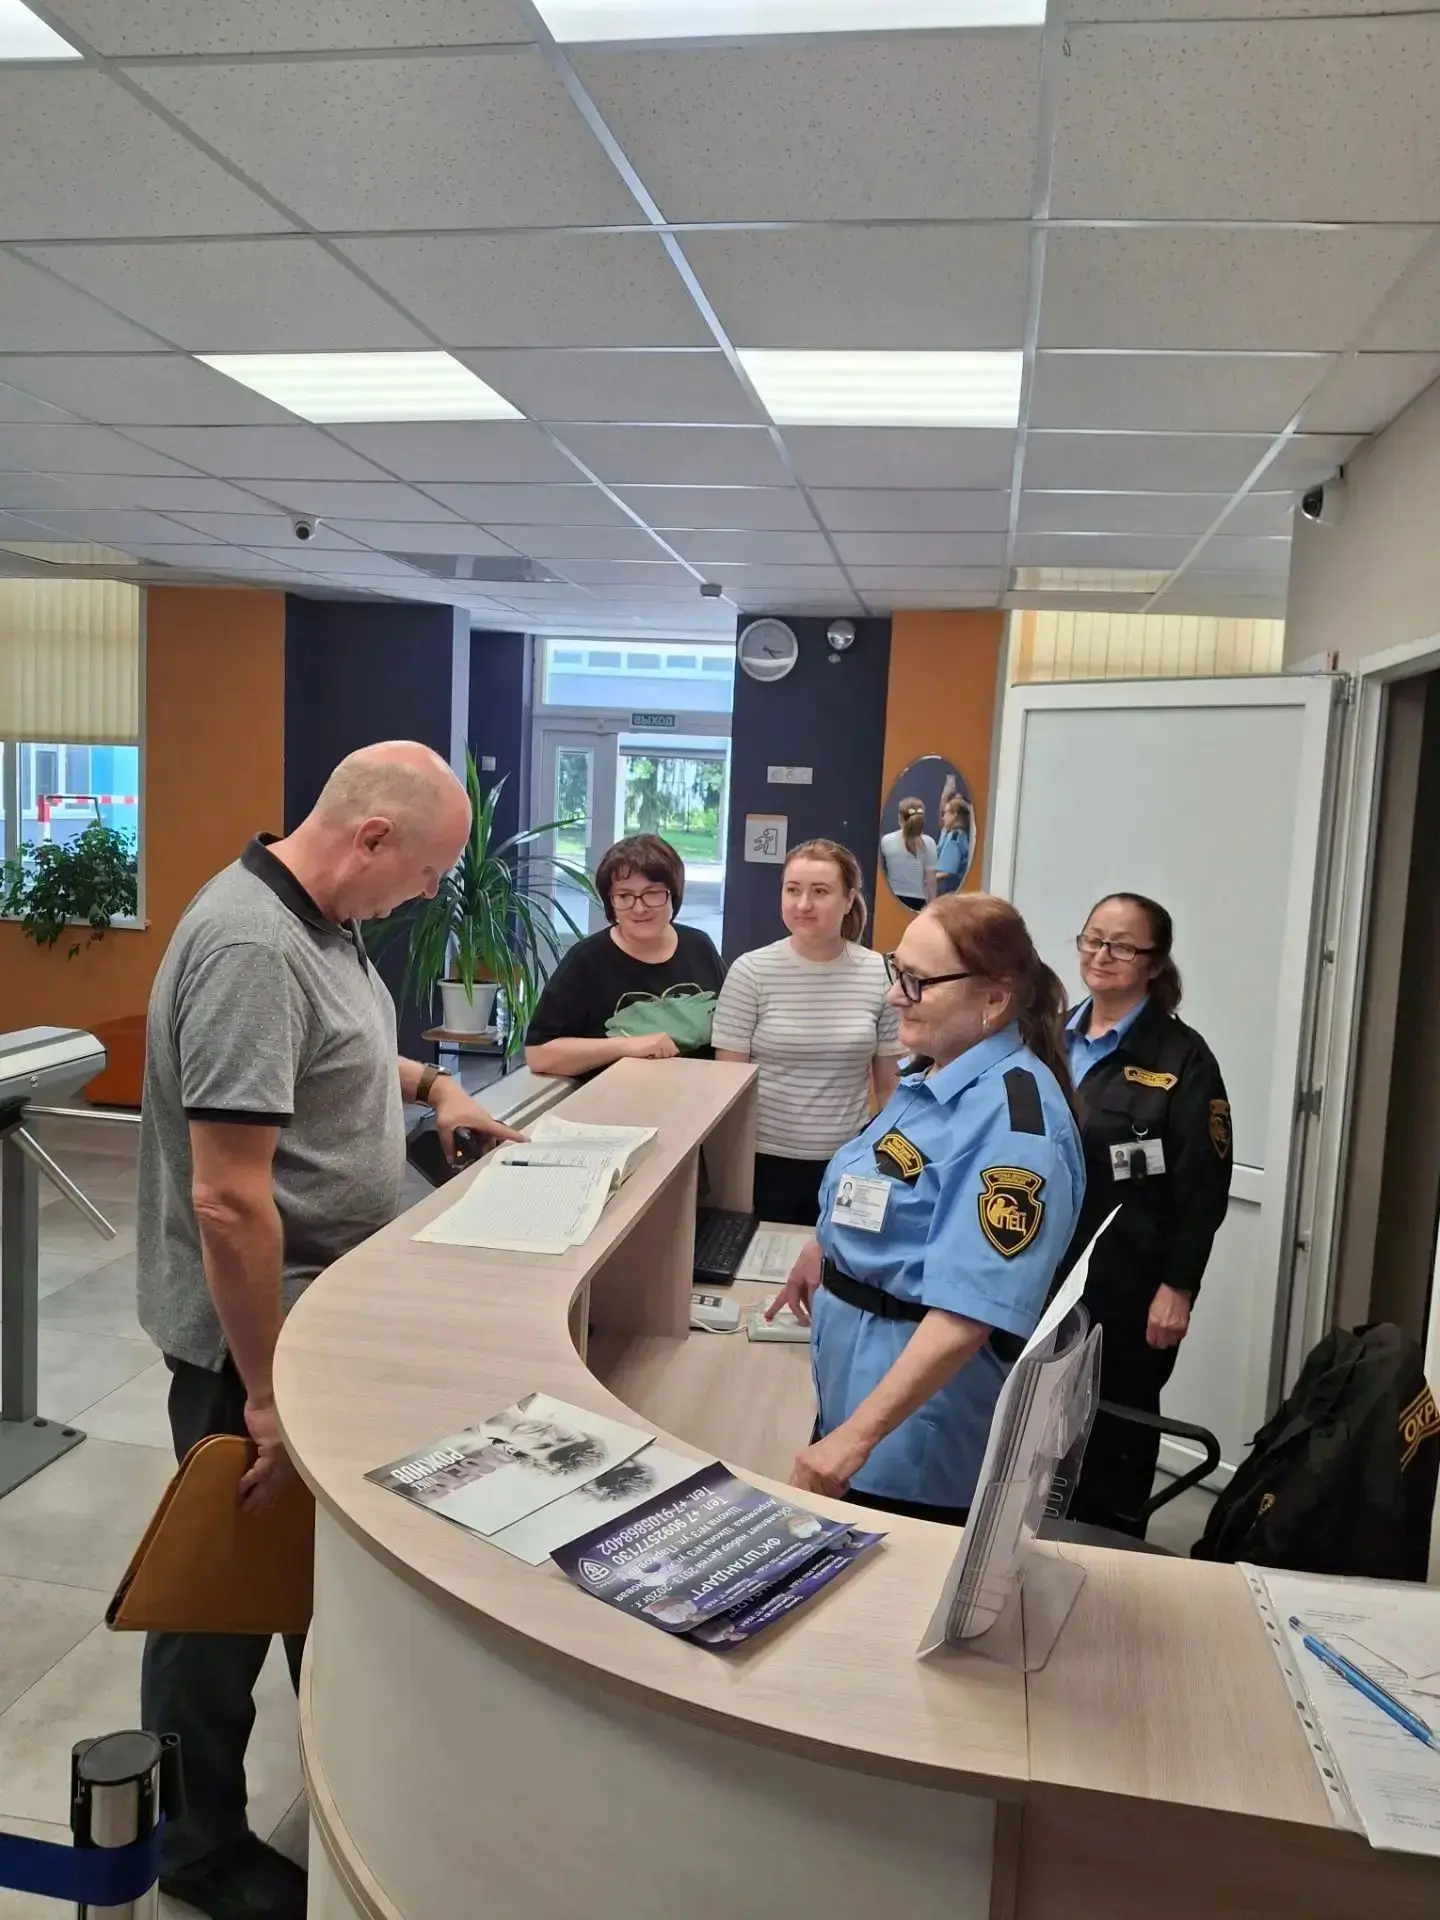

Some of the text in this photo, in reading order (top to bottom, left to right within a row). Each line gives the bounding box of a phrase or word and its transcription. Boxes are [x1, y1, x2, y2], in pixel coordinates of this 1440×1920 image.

[634, 715, 673, 726] ВЫХОД
[1405, 1400, 1440, 1442] ОХР
[390, 1446, 466, 1485] РОЖНОВ
[596, 1486, 716, 1556] Тел. +7 9105868402
[707, 1505, 743, 1526] Школа
[612, 1496, 729, 1565] Тел. +7 9092577130
[691, 1524, 712, 1538] №3
[703, 1526, 736, 1546] Школа
[628, 1544, 679, 1576] Парковая
[694, 1548, 723, 1569] детей
